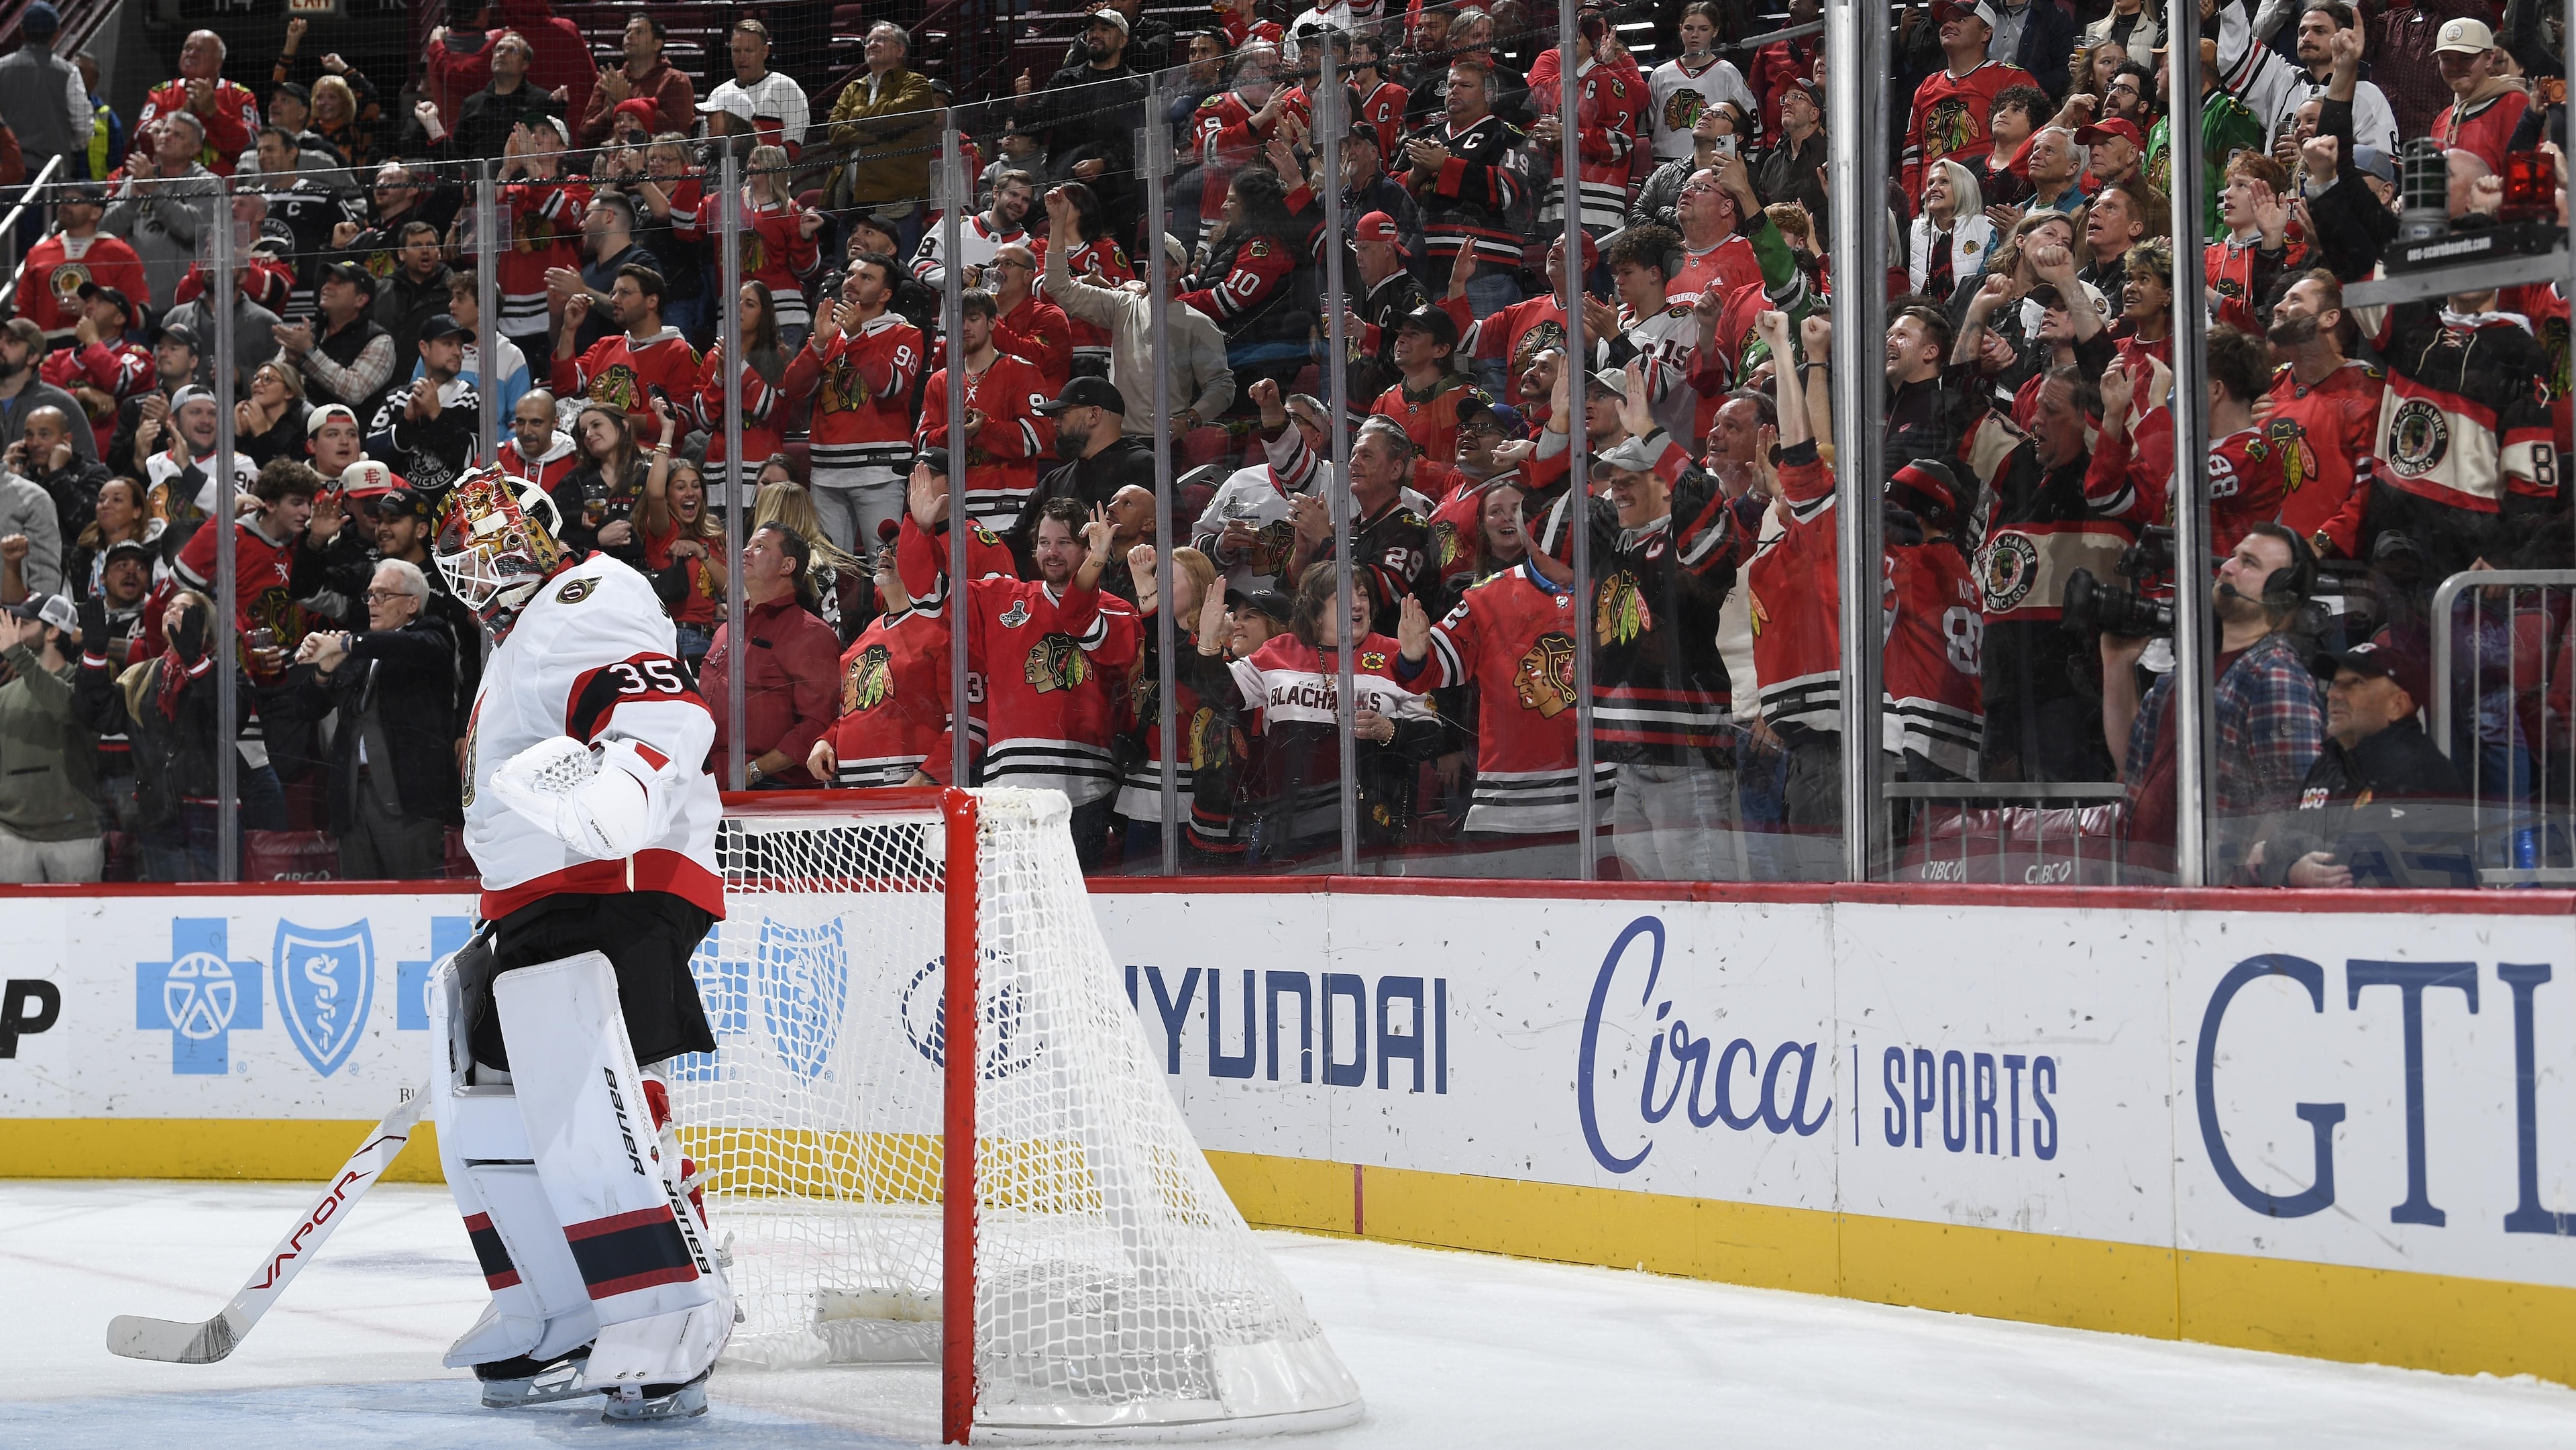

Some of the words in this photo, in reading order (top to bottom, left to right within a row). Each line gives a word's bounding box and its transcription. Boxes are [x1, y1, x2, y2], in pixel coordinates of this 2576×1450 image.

[1377, 103, 1389, 123] C
[1463, 132, 1485, 149] C
[1505, 148, 1529, 176] 19
[287, 201, 301, 217] C
[917, 236, 936, 257] 8
[1226, 268, 1261, 297] 10
[894, 344, 918, 377] 98
[2390, 403, 2415, 436] BLACK
[2418, 403, 2447, 440] HAWKS
[405, 469, 450, 486] CHICAGO
[2390, 453, 2435, 475] CHICAGO
[2530, 442, 2557, 487] 8
[2004, 535, 2035, 564] HAWKS
[1385, 546, 1424, 583] 29
[429, 587, 445, 598] ebok
[1987, 583, 2028, 609] CHICAGO
[1442, 599, 1470, 630] 2
[608, 660, 684, 694] 35
[1578, 916, 1832, 1174] Circa
[1884, 1046, 2057, 1161] SPORTS
[248, 1170, 374, 1290] VAPOR
